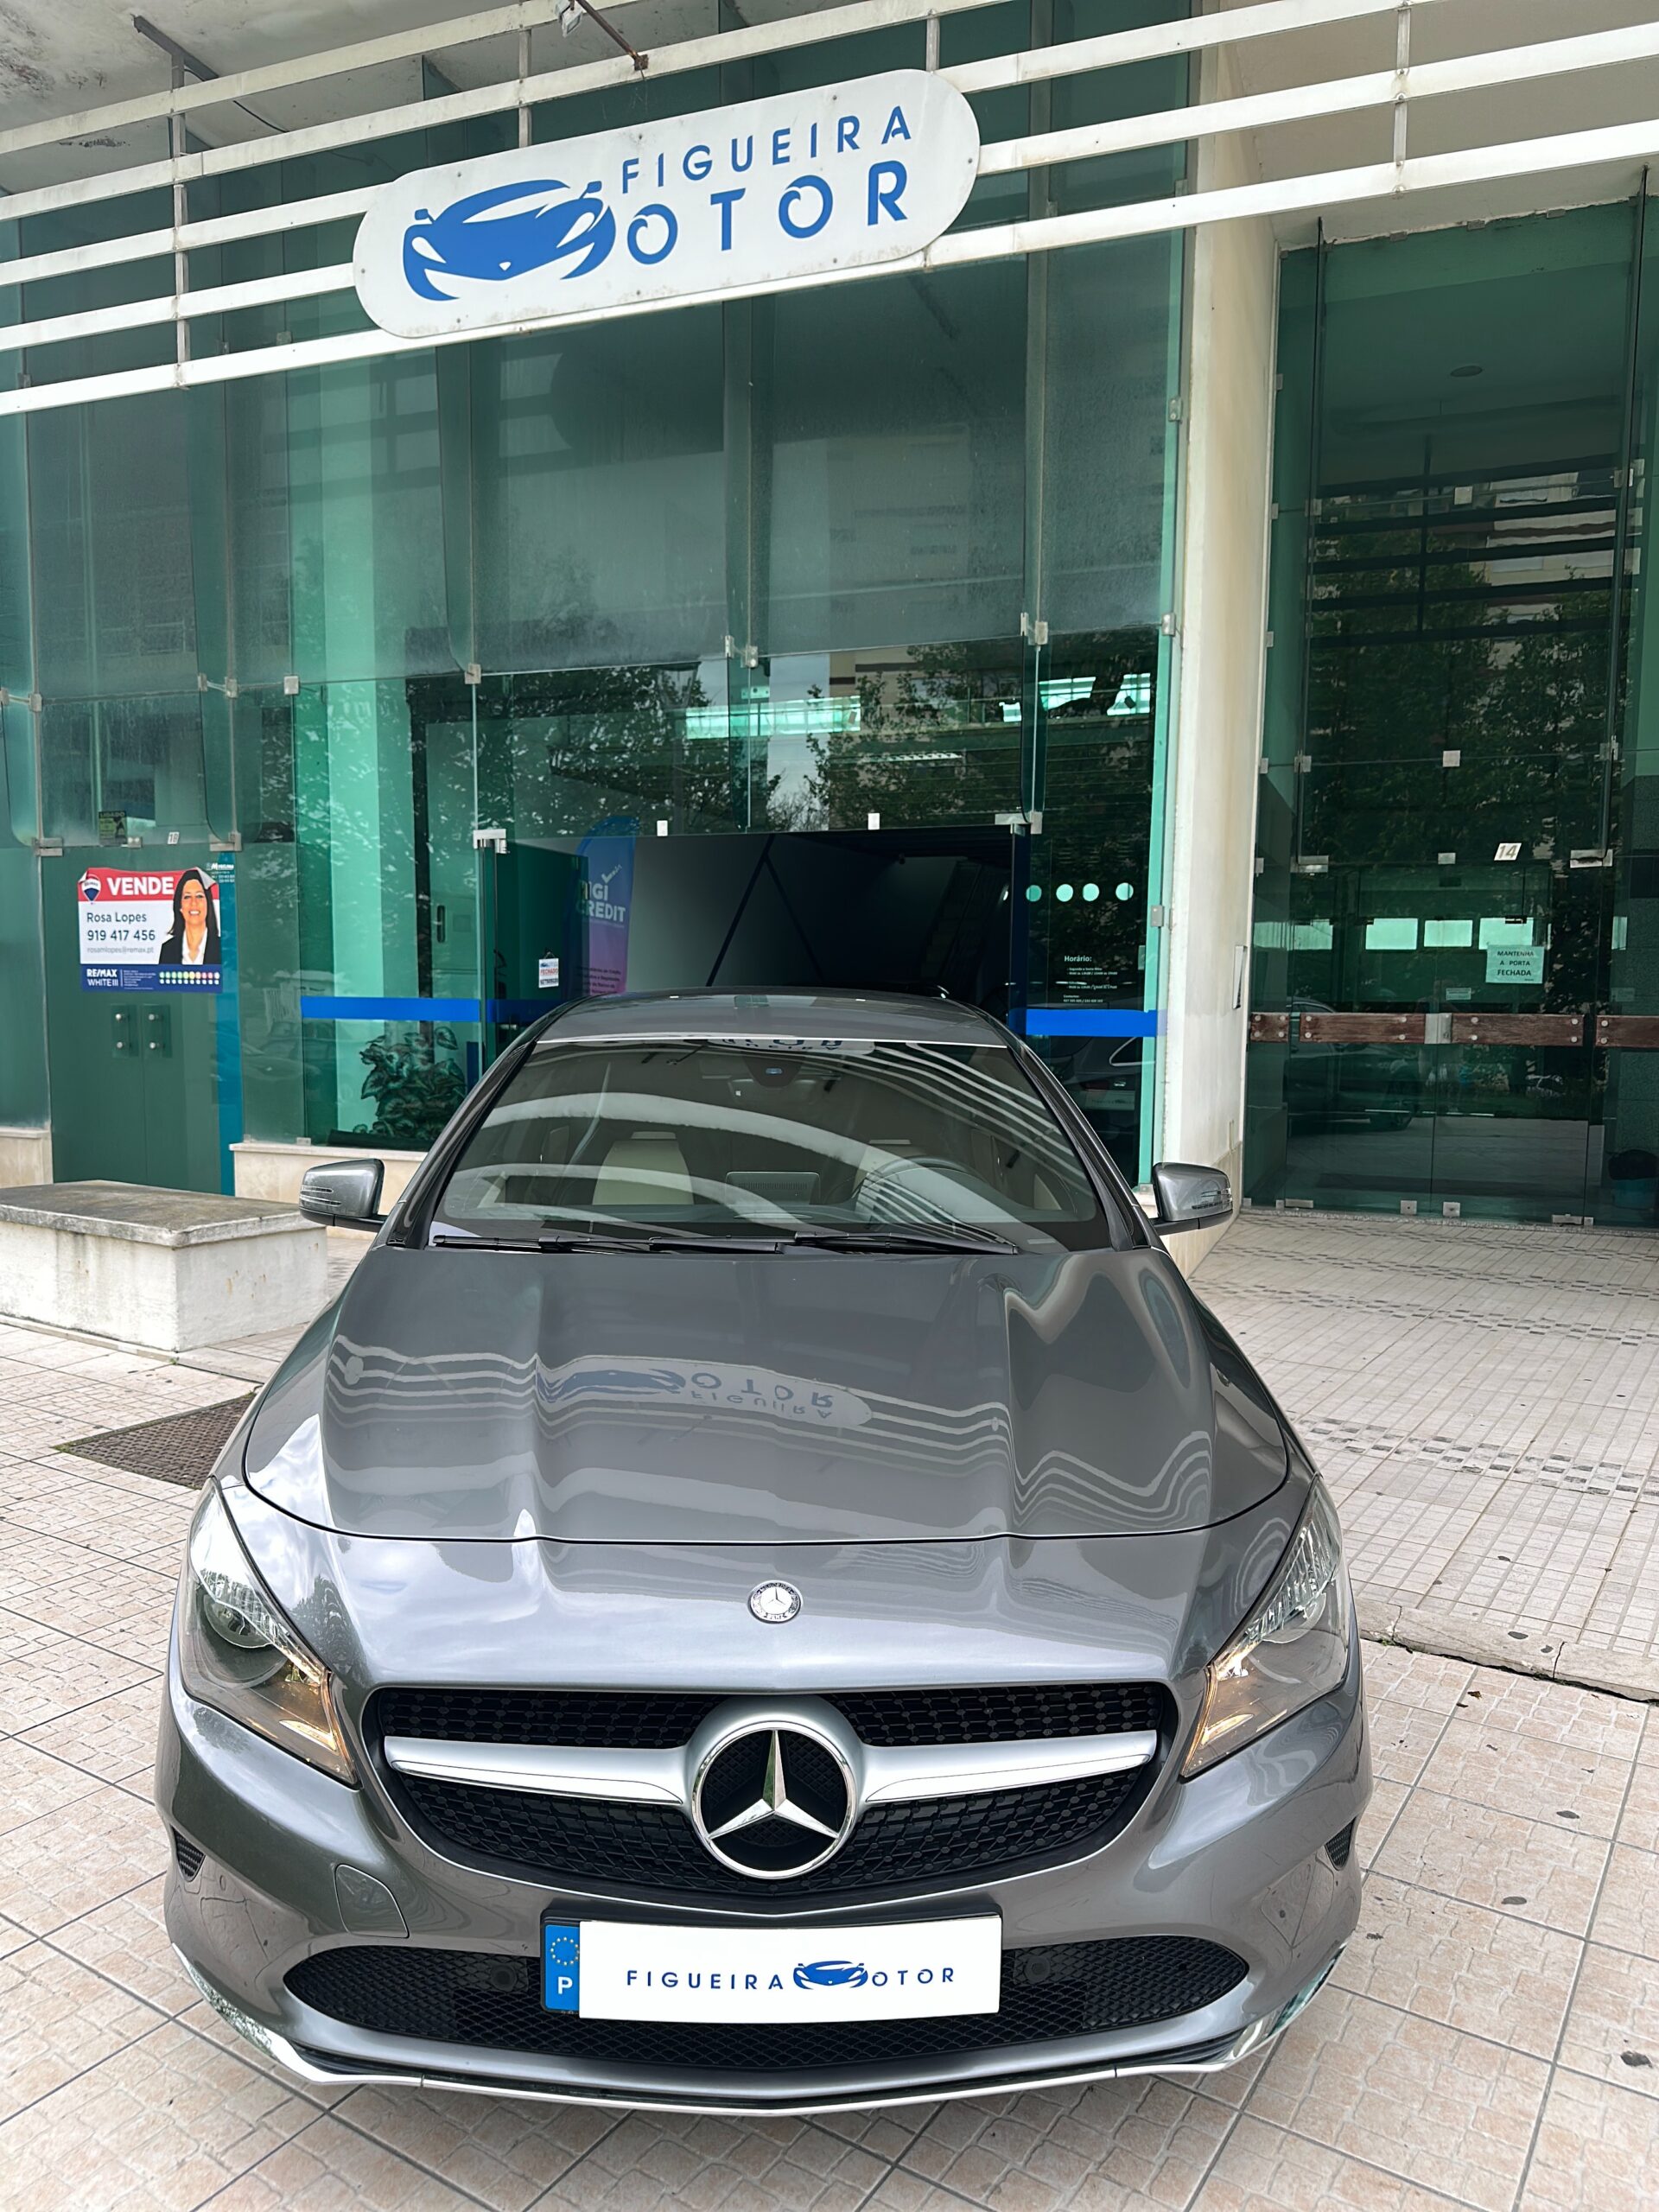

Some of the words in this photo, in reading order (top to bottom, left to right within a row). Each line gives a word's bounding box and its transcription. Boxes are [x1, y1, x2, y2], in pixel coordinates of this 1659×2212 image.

[622, 105, 912, 194] FIGUEIRA
[1497, 845, 1517, 859] 14
[106, 876, 175, 896] VENDE
[86, 912, 111, 923] Rosa
[115, 912, 147, 925] Lopes
[87, 930, 106, 941] 919
[111, 930, 130, 941] 417
[133, 930, 156, 941] 456
[86, 969, 118, 977] RE/MAX
[87, 978, 111, 987] WHITE
[557, 1976, 573, 1995] P
[626, 1969, 784, 1990] FIGUEIRA
